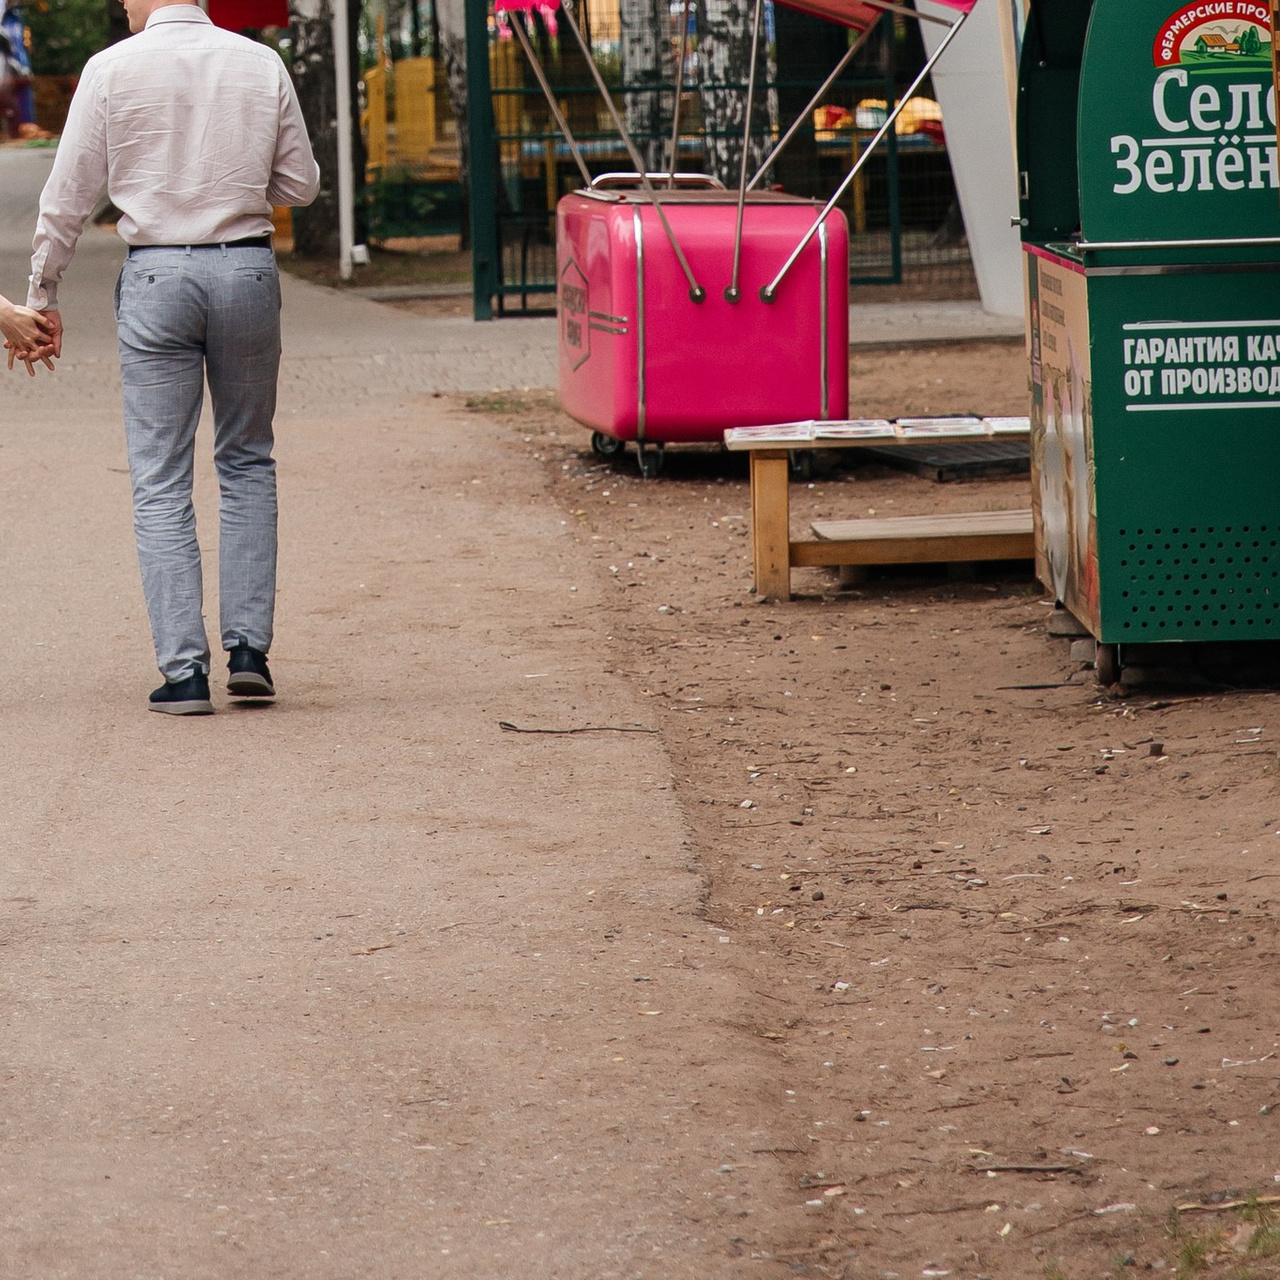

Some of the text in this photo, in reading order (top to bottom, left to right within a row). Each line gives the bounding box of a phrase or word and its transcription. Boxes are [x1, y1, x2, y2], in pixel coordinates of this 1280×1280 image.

[1161, 2, 1233, 61] ФЕРМЕРСКИЕ
[1123, 337, 1240, 365] ГАРАНТИЯ
[1124, 369, 1154, 396] ОТ
